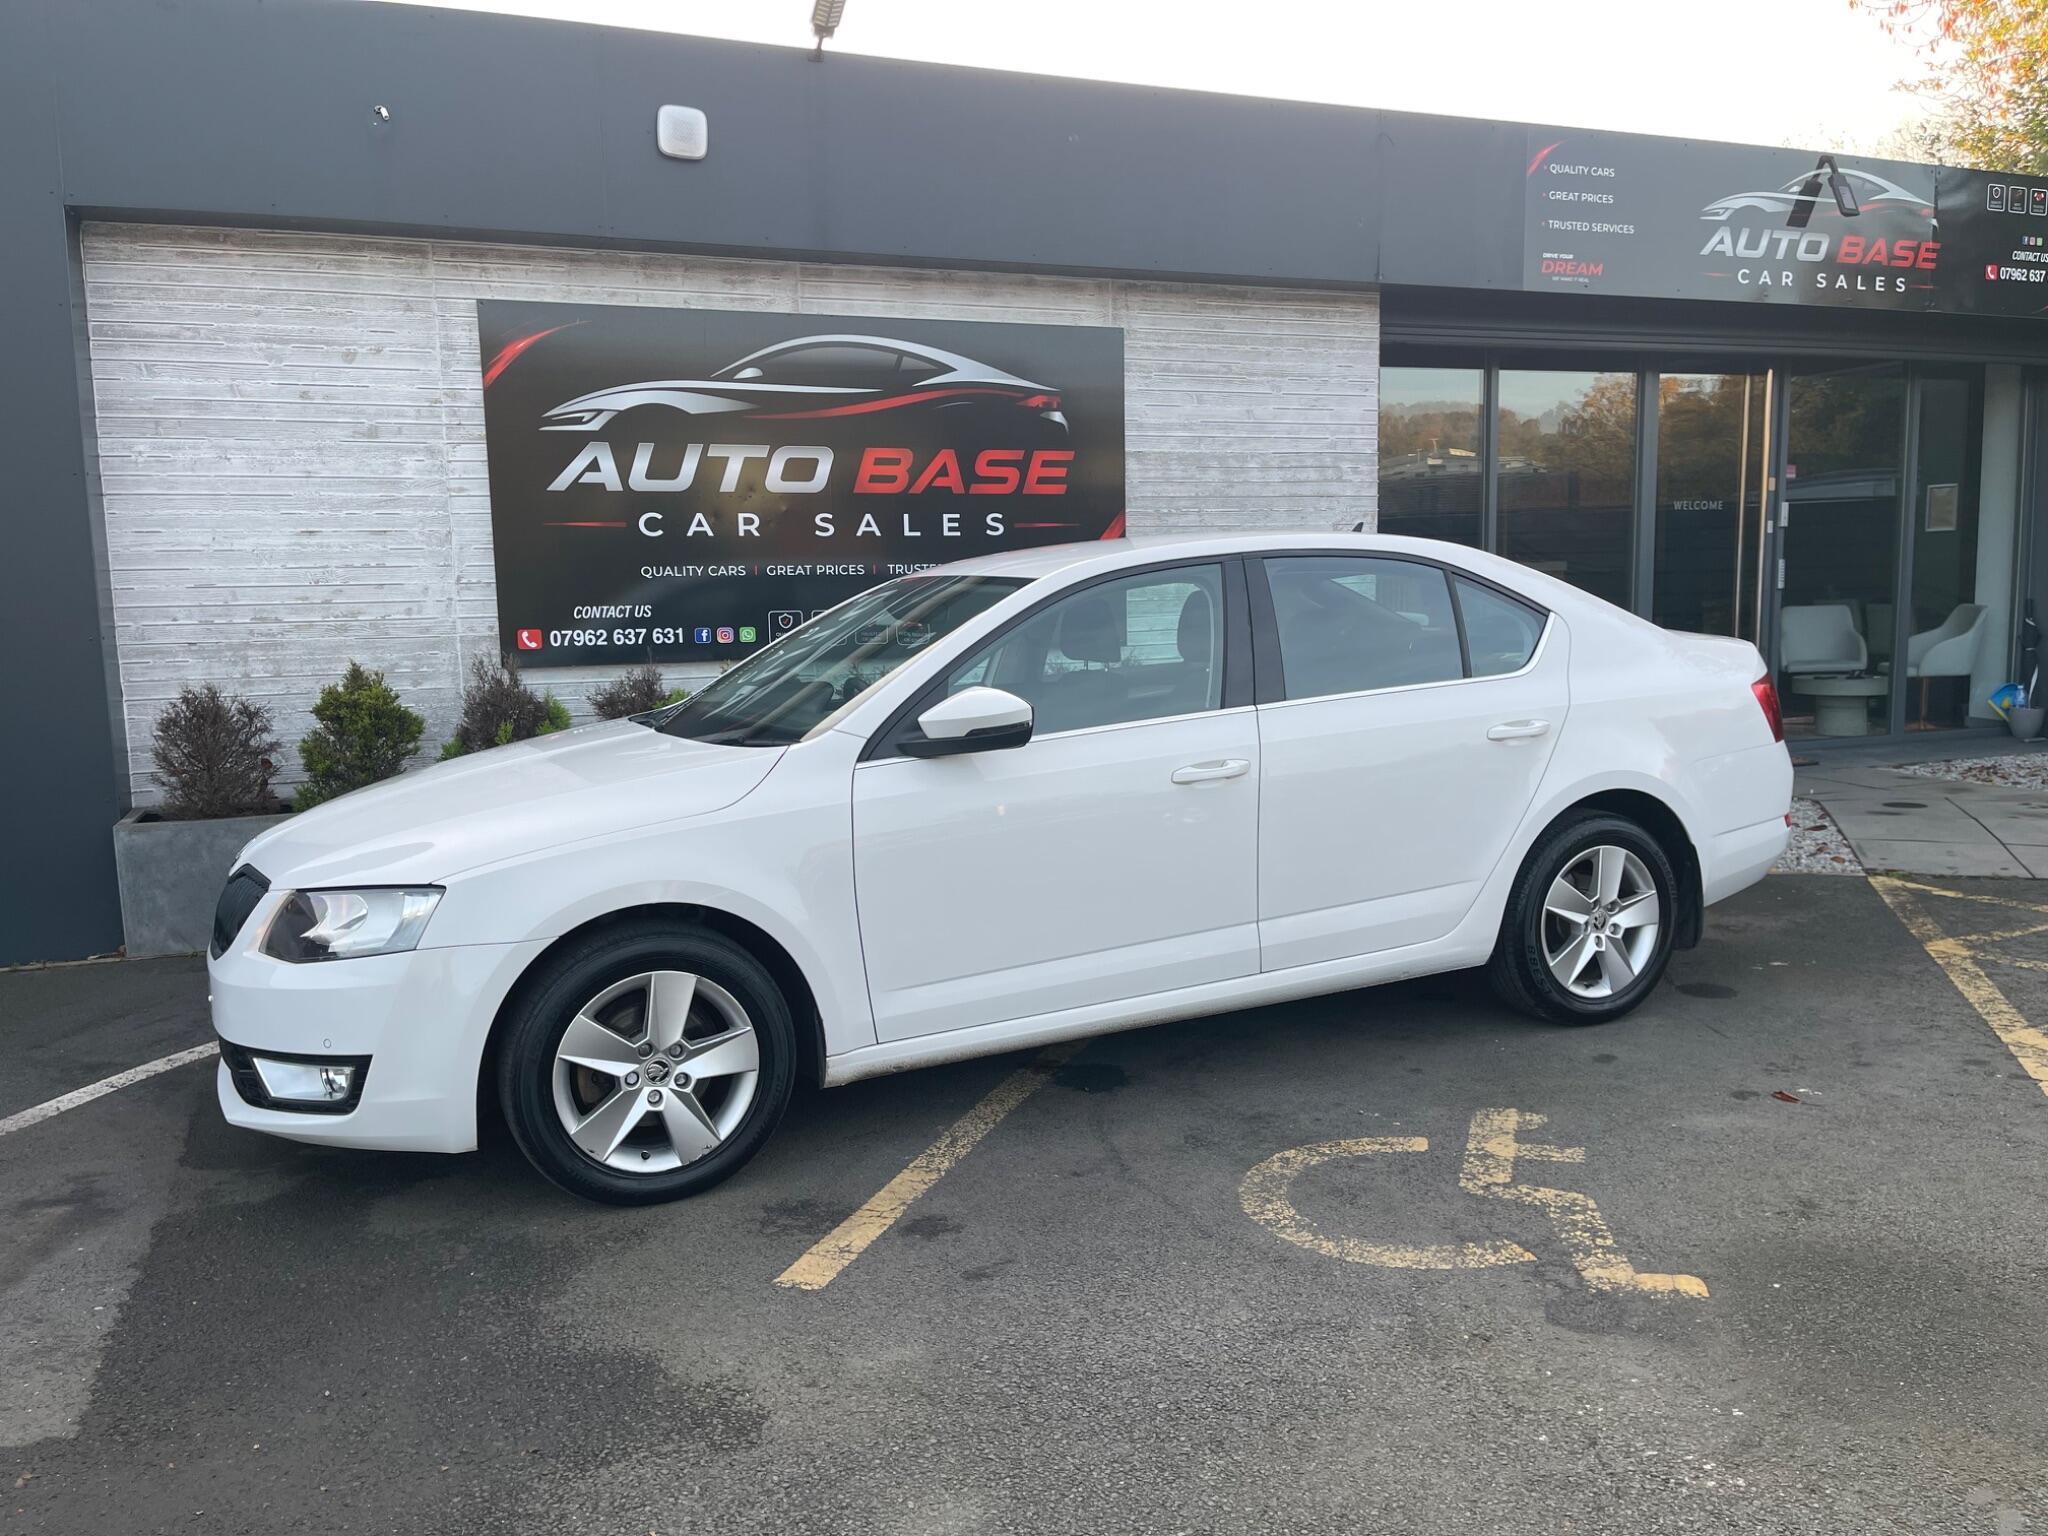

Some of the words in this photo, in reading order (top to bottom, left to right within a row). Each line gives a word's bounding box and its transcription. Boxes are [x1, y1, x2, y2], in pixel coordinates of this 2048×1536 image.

[1549, 163, 1589, 176] QUALITY
[1591, 167, 1616, 178] CARS
[1549, 191, 1580, 202] GREAT
[1581, 193, 1614, 204] PRICES
[1548, 220, 1590, 231] TRUSTED
[1591, 223, 1635, 234] SERVICES
[1700, 226, 1830, 262] AUTO
[1836, 234, 1942, 269] BASE
[2012, 250, 2041, 262] CONTACT
[1541, 259, 1603, 276] DREAM
[1999, 267, 2028, 281] 07962
[2029, 268, 2046, 283] 637
[1737, 268, 1794, 286] CAR
[1816, 273, 1906, 292] SALES
[546, 441, 835, 494] AUTO
[853, 447, 1075, 495] BASE
[1673, 500, 1724, 511] WELCOME
[638, 511, 761, 537] CAR
[814, 511, 1005, 537] SALES
[640, 565, 704, 579] QUALITY
[708, 565, 747, 577] CARS
[766, 564, 812, 576] GREAT
[816, 564, 865, 576] PRICES
[573, 604, 632, 619] CONTACT
[634, 604, 652, 618] US
[550, 629, 608, 647] 07962
[613, 628, 647, 645] 637
[652, 627, 684, 644] 631
